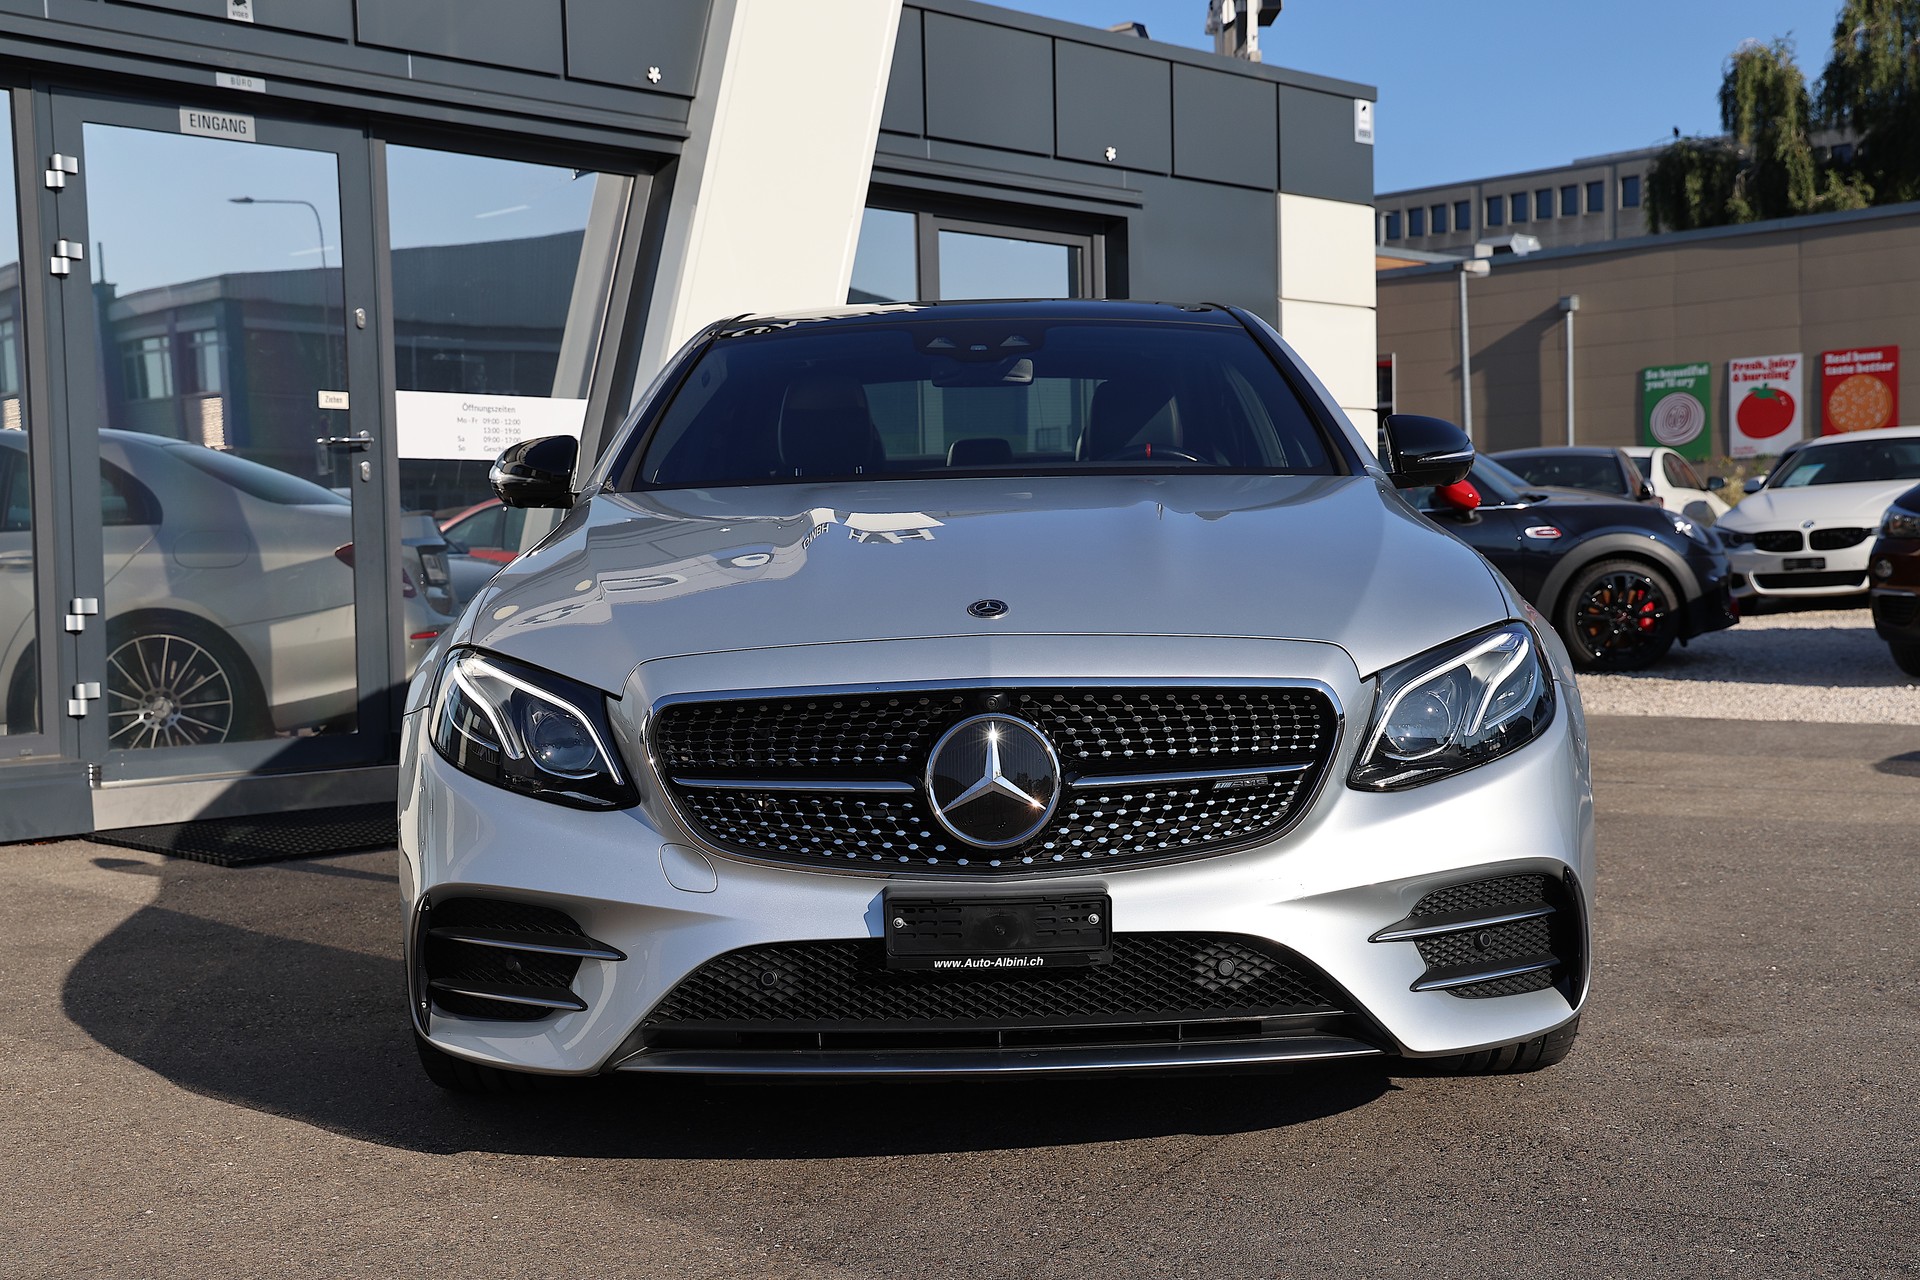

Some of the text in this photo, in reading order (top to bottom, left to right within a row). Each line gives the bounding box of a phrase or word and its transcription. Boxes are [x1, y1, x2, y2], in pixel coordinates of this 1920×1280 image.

[189, 113, 247, 135] EINGANG
[1825, 351, 1883, 365] Real buns
[1645, 364, 1709, 380] So beautiful
[1768, 358, 1796, 373] juicy
[1825, 362, 1895, 376] taste better
[1677, 378, 1696, 389] cry
[1742, 371, 1790, 382] bursting
[462, 402, 516, 413] Öffnungszeiten
[933, 956, 1044, 968] www.Auto-Albini.ch
